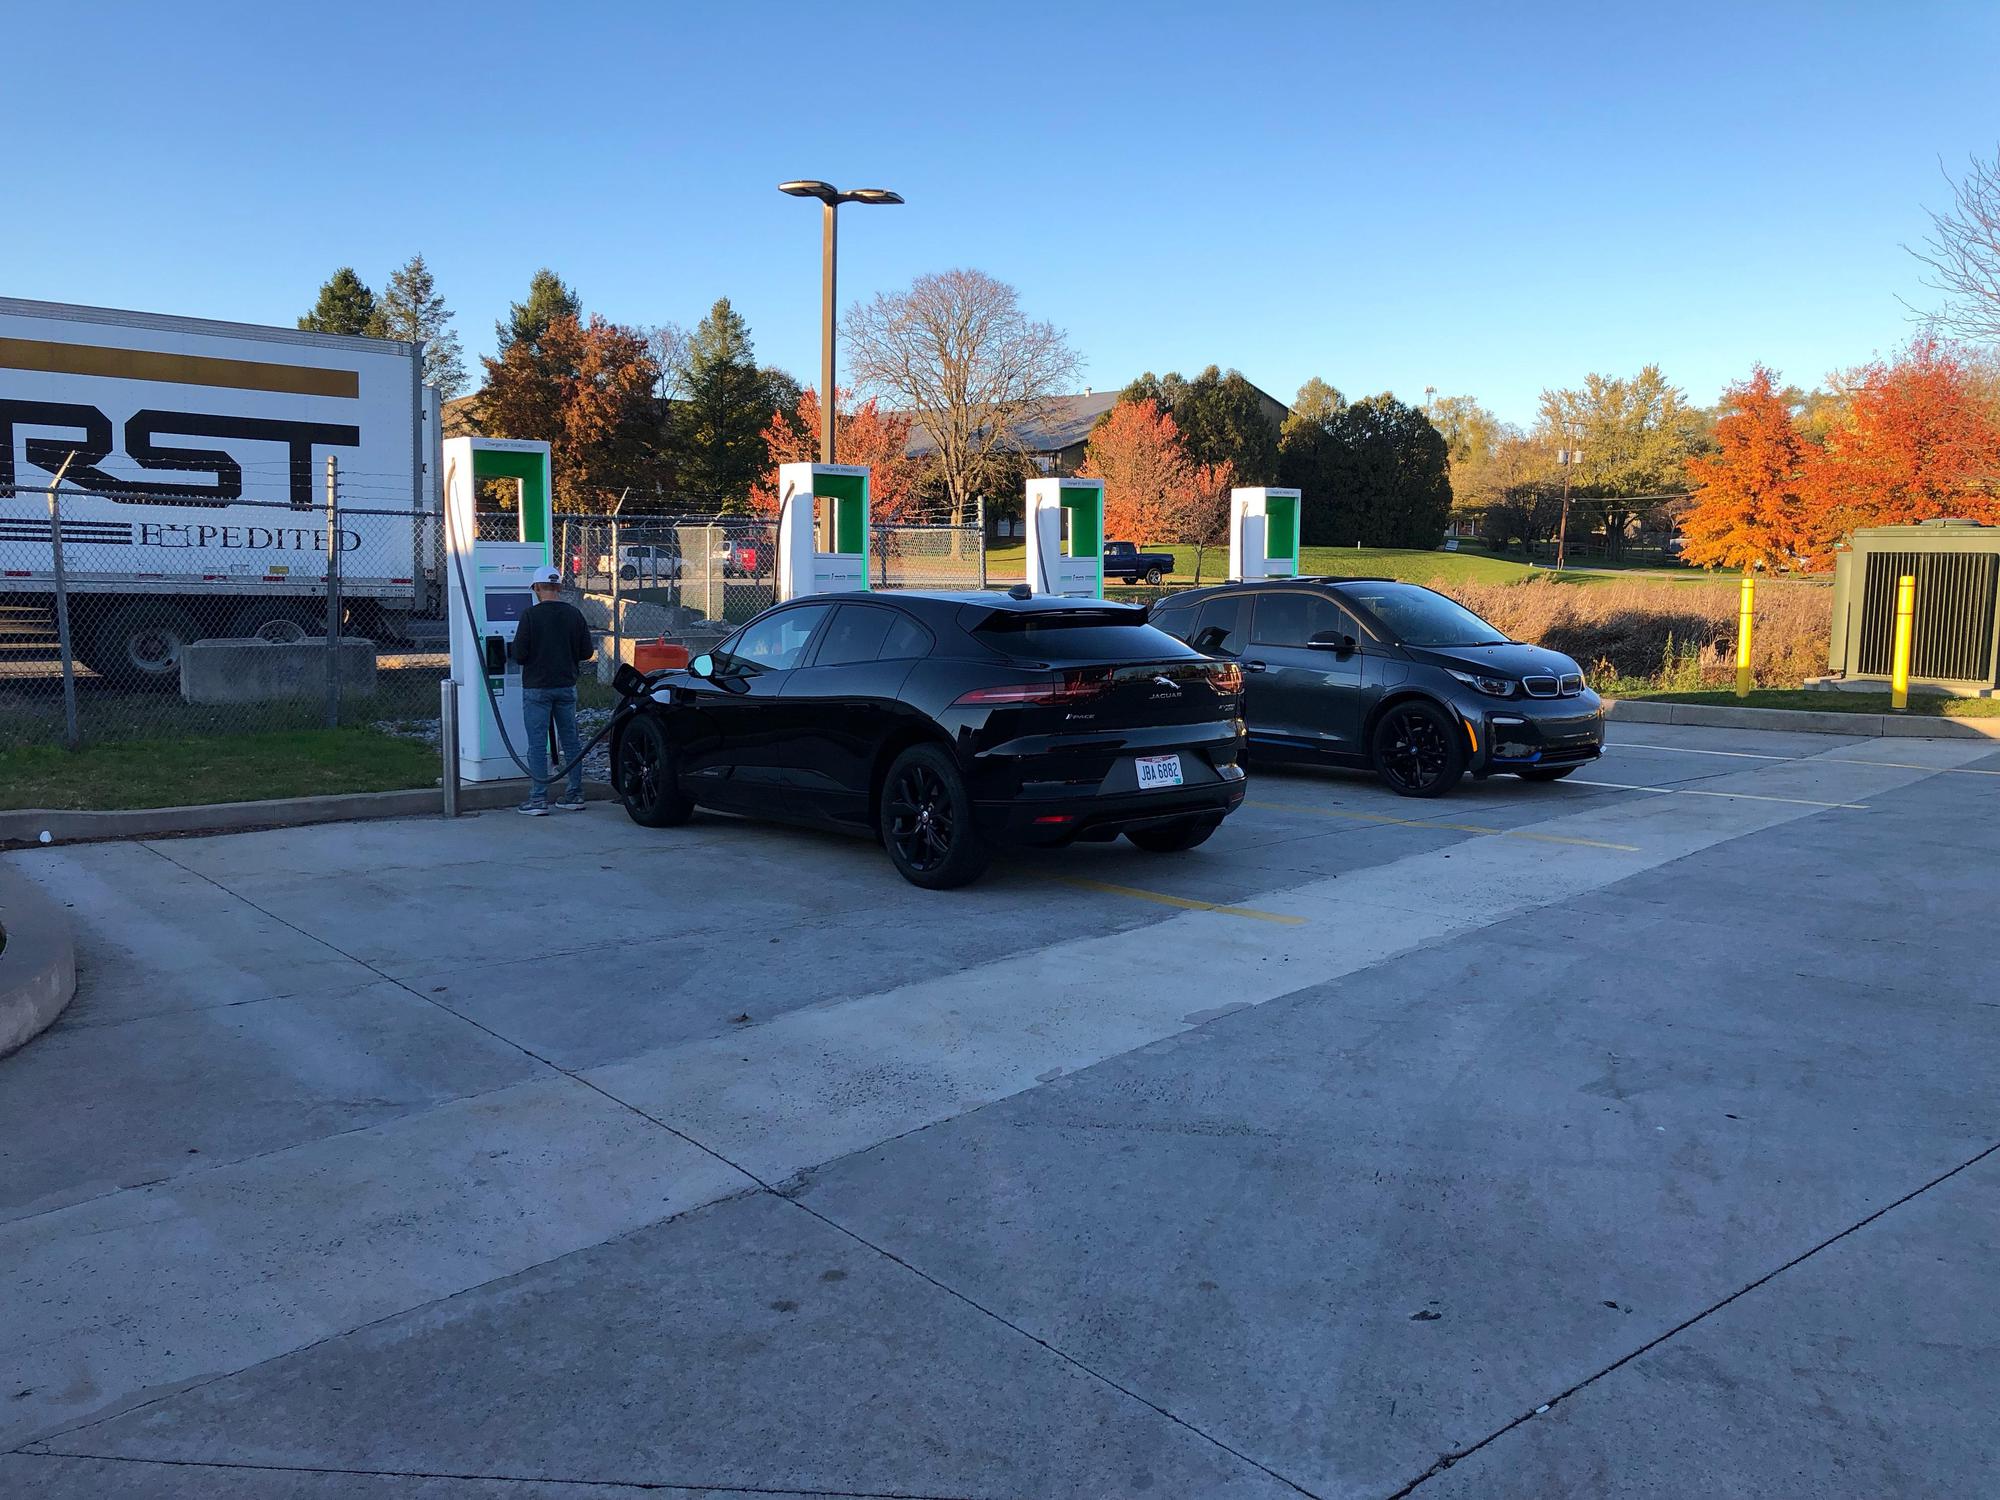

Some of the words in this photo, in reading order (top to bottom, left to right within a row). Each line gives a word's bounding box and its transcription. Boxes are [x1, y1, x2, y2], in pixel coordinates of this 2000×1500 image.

[138, 522, 362, 552] EPEDITED
[1149, 692, 1182, 700] JAGUAR
[1141, 765, 1157, 781] JBA
[1157, 762, 1179, 779] 6882
